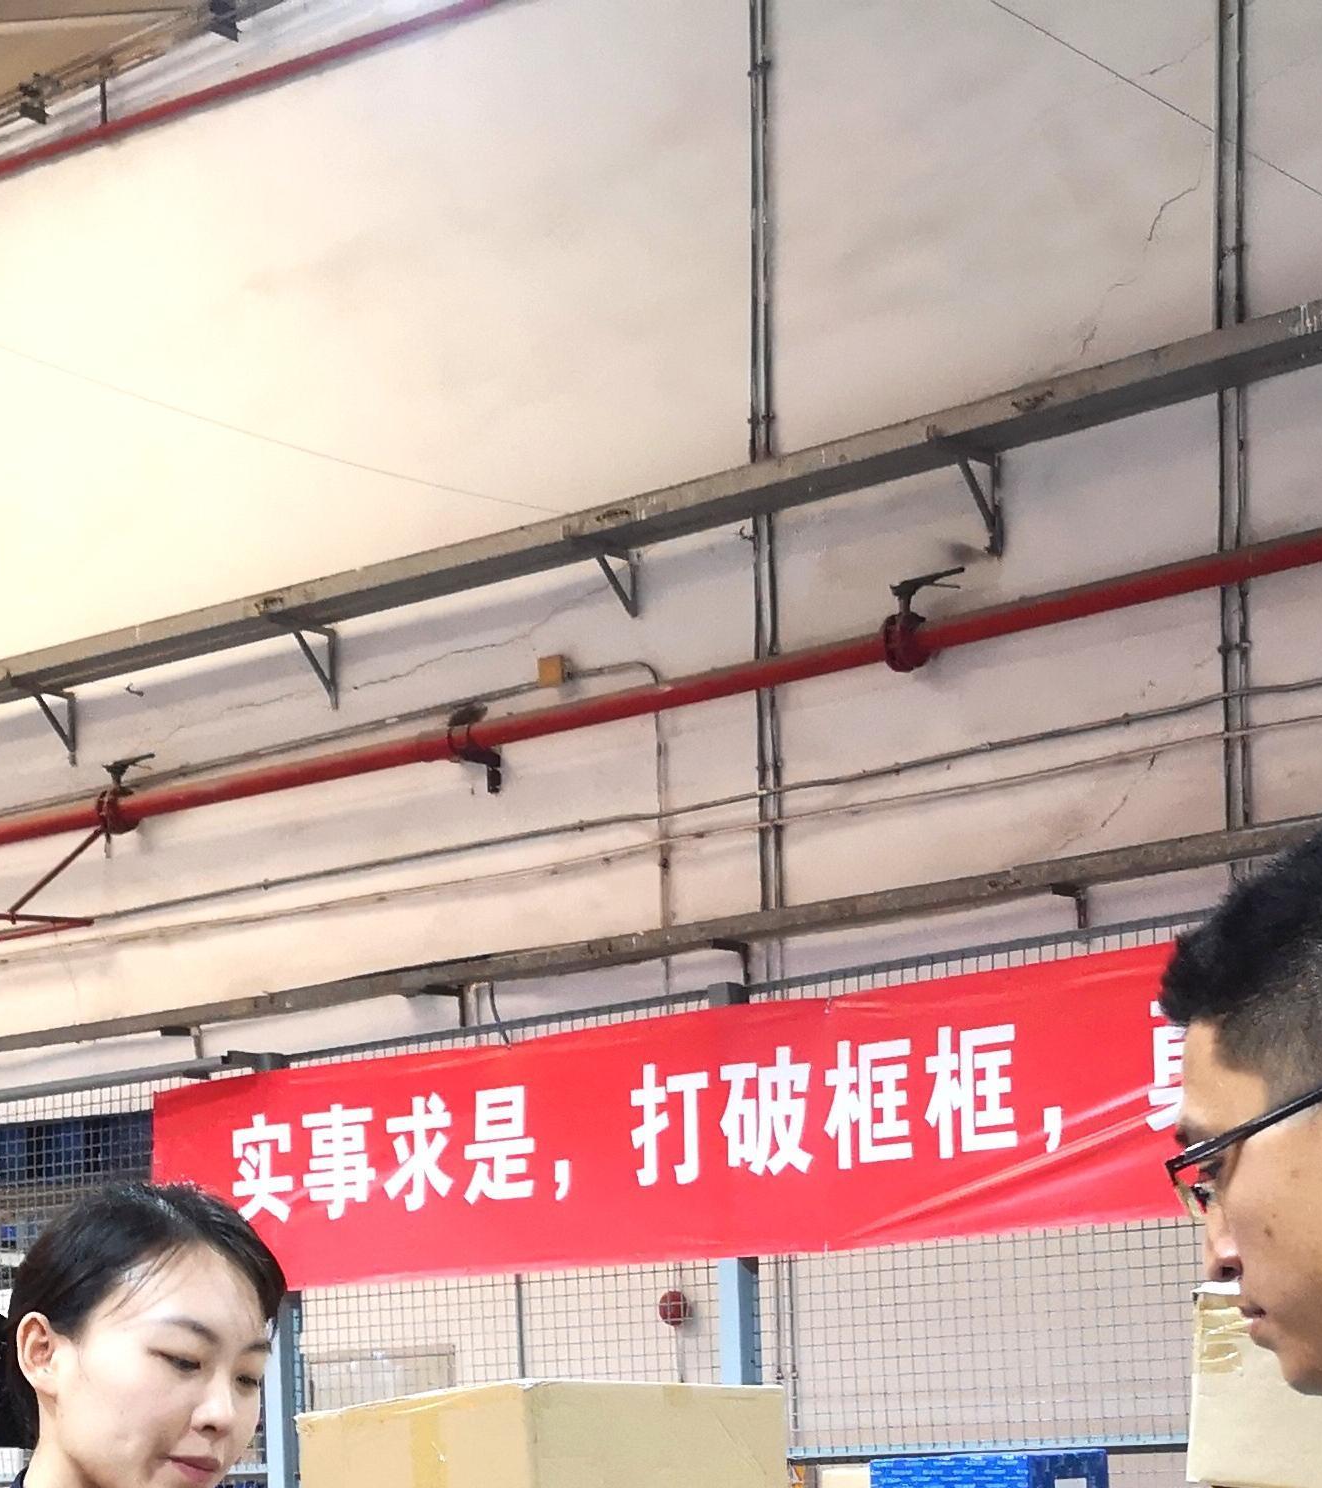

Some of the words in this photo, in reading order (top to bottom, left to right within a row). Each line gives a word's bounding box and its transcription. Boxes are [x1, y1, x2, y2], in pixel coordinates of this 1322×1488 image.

[232, 1085, 571, 1223] 实事求是，
[630, 1023, 1063, 1187] 打破框框，
